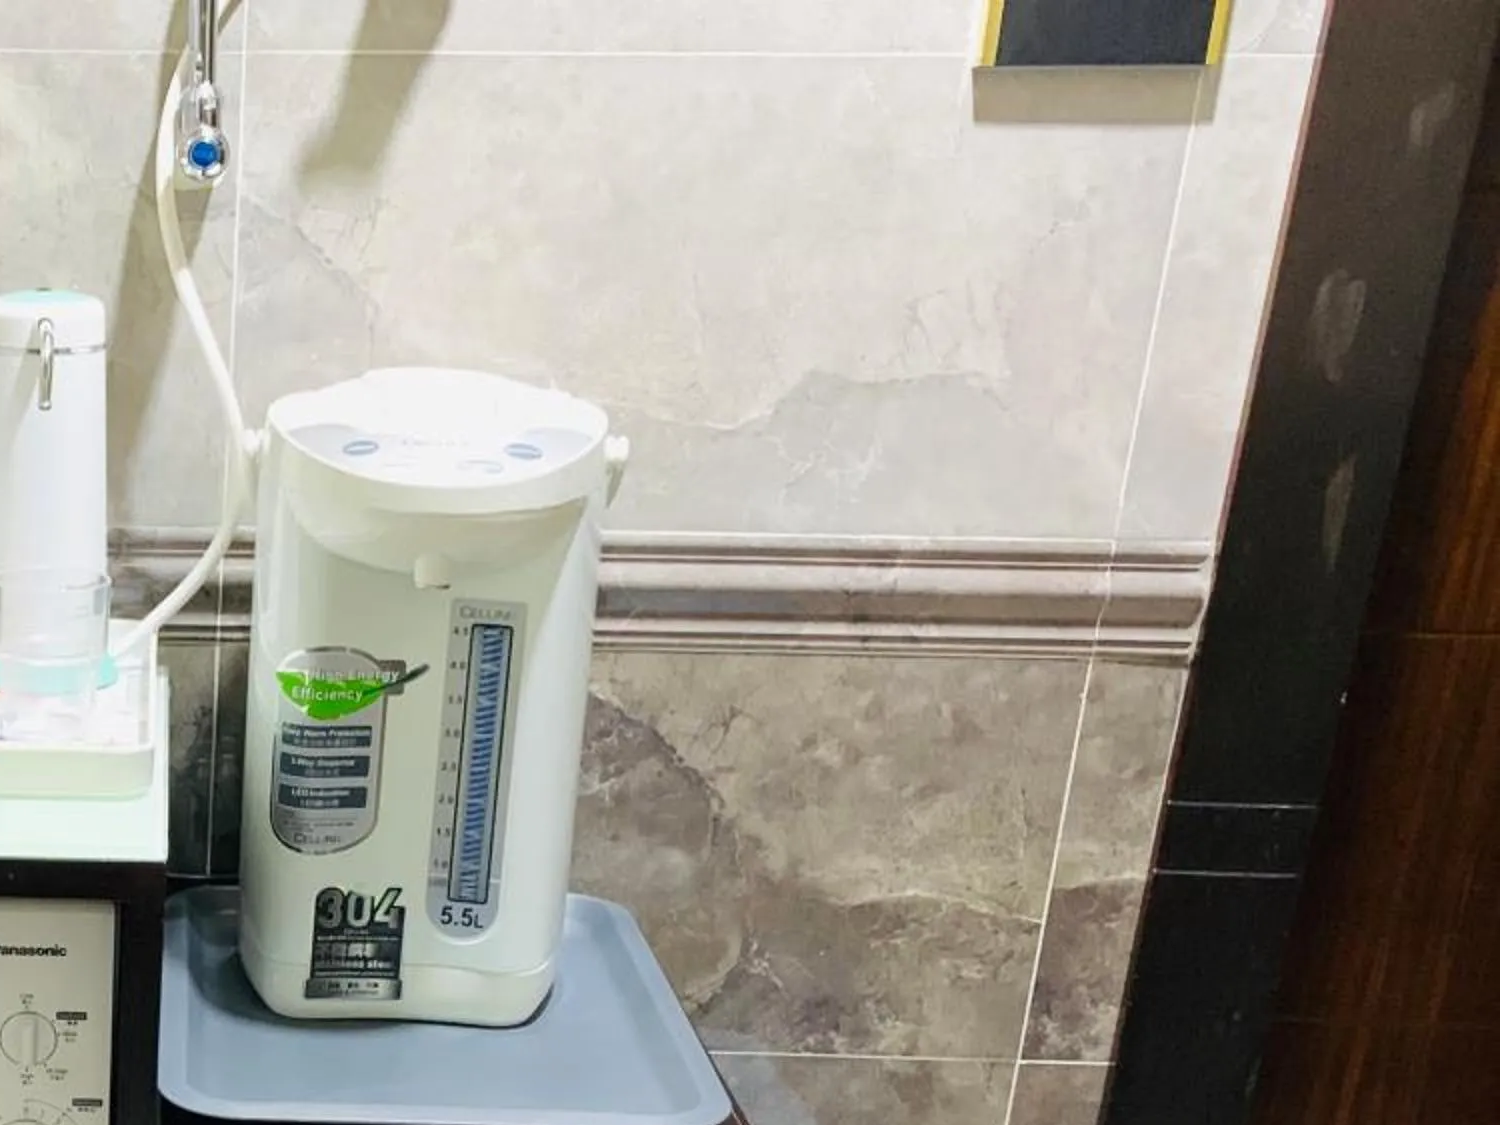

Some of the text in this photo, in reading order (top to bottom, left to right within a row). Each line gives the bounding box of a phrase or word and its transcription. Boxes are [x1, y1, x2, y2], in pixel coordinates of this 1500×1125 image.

[291, 685, 363, 702] Efficiency
[317, 888, 402, 929] 304
[440, 906, 484, 929] 5.5L
